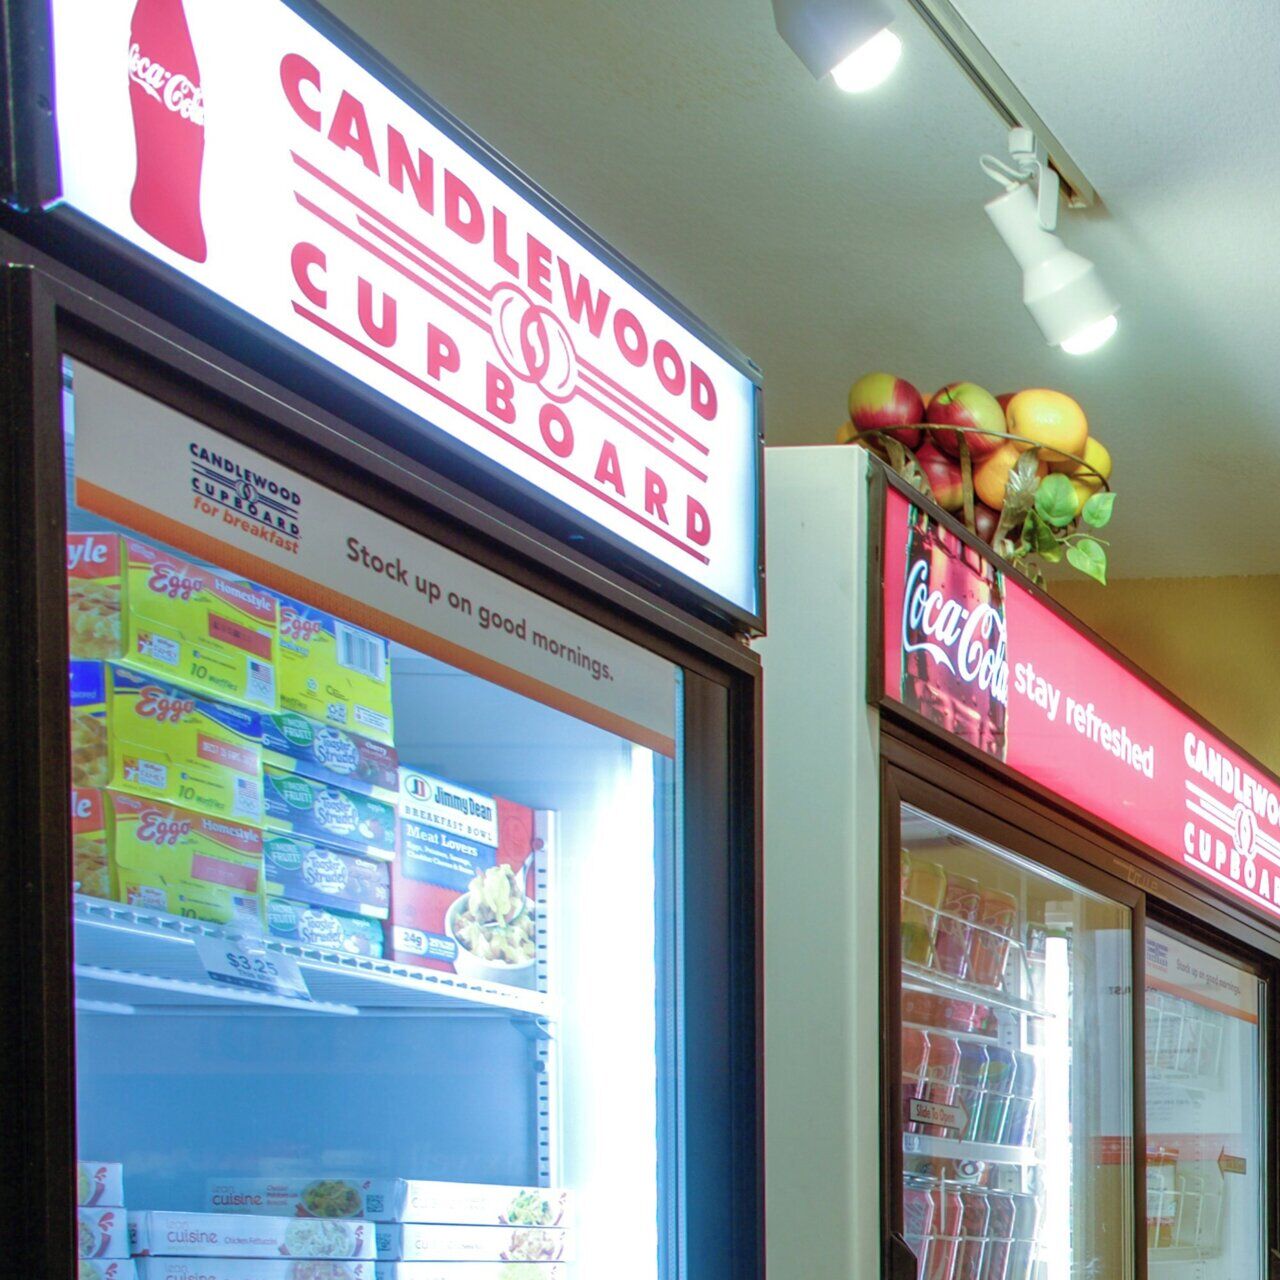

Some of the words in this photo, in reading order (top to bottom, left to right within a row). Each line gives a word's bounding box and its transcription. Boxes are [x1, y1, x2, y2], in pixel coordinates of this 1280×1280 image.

[280, 53, 717, 422] CANDLEWOOD
[291, 242, 711, 546] CUPBOARD
[190, 443, 301, 505] CANDLEWOOD
[192, 477, 300, 536] CUPBOARD
[193, 496, 220, 517] for
[223, 508, 299, 555] breakfast
[147, 560, 204, 600] Eggo
[215, 578, 272, 612] Homestyle
[347, 537, 408, 587] Stock
[415, 574, 442, 606] up
[448, 591, 473, 614] on
[478, 601, 528, 640] good
[532, 630, 615, 681] mornings.
[902, 559, 1010, 708] Coca-Cola
[135, 686, 195, 724] Eggo
[1014, 660, 1062, 721] stay
[1065, 694, 1155, 779] refreshed
[136, 808, 193, 847] Eggo
[202, 818, 261, 844] Homestyle
[434, 786, 470, 816] Jimmy
[469, 798, 493, 822] Dean
[406, 823, 440, 846] Meat
[226, 952, 278, 977] $3.25
[167, 1228, 218, 1244] cuisine
